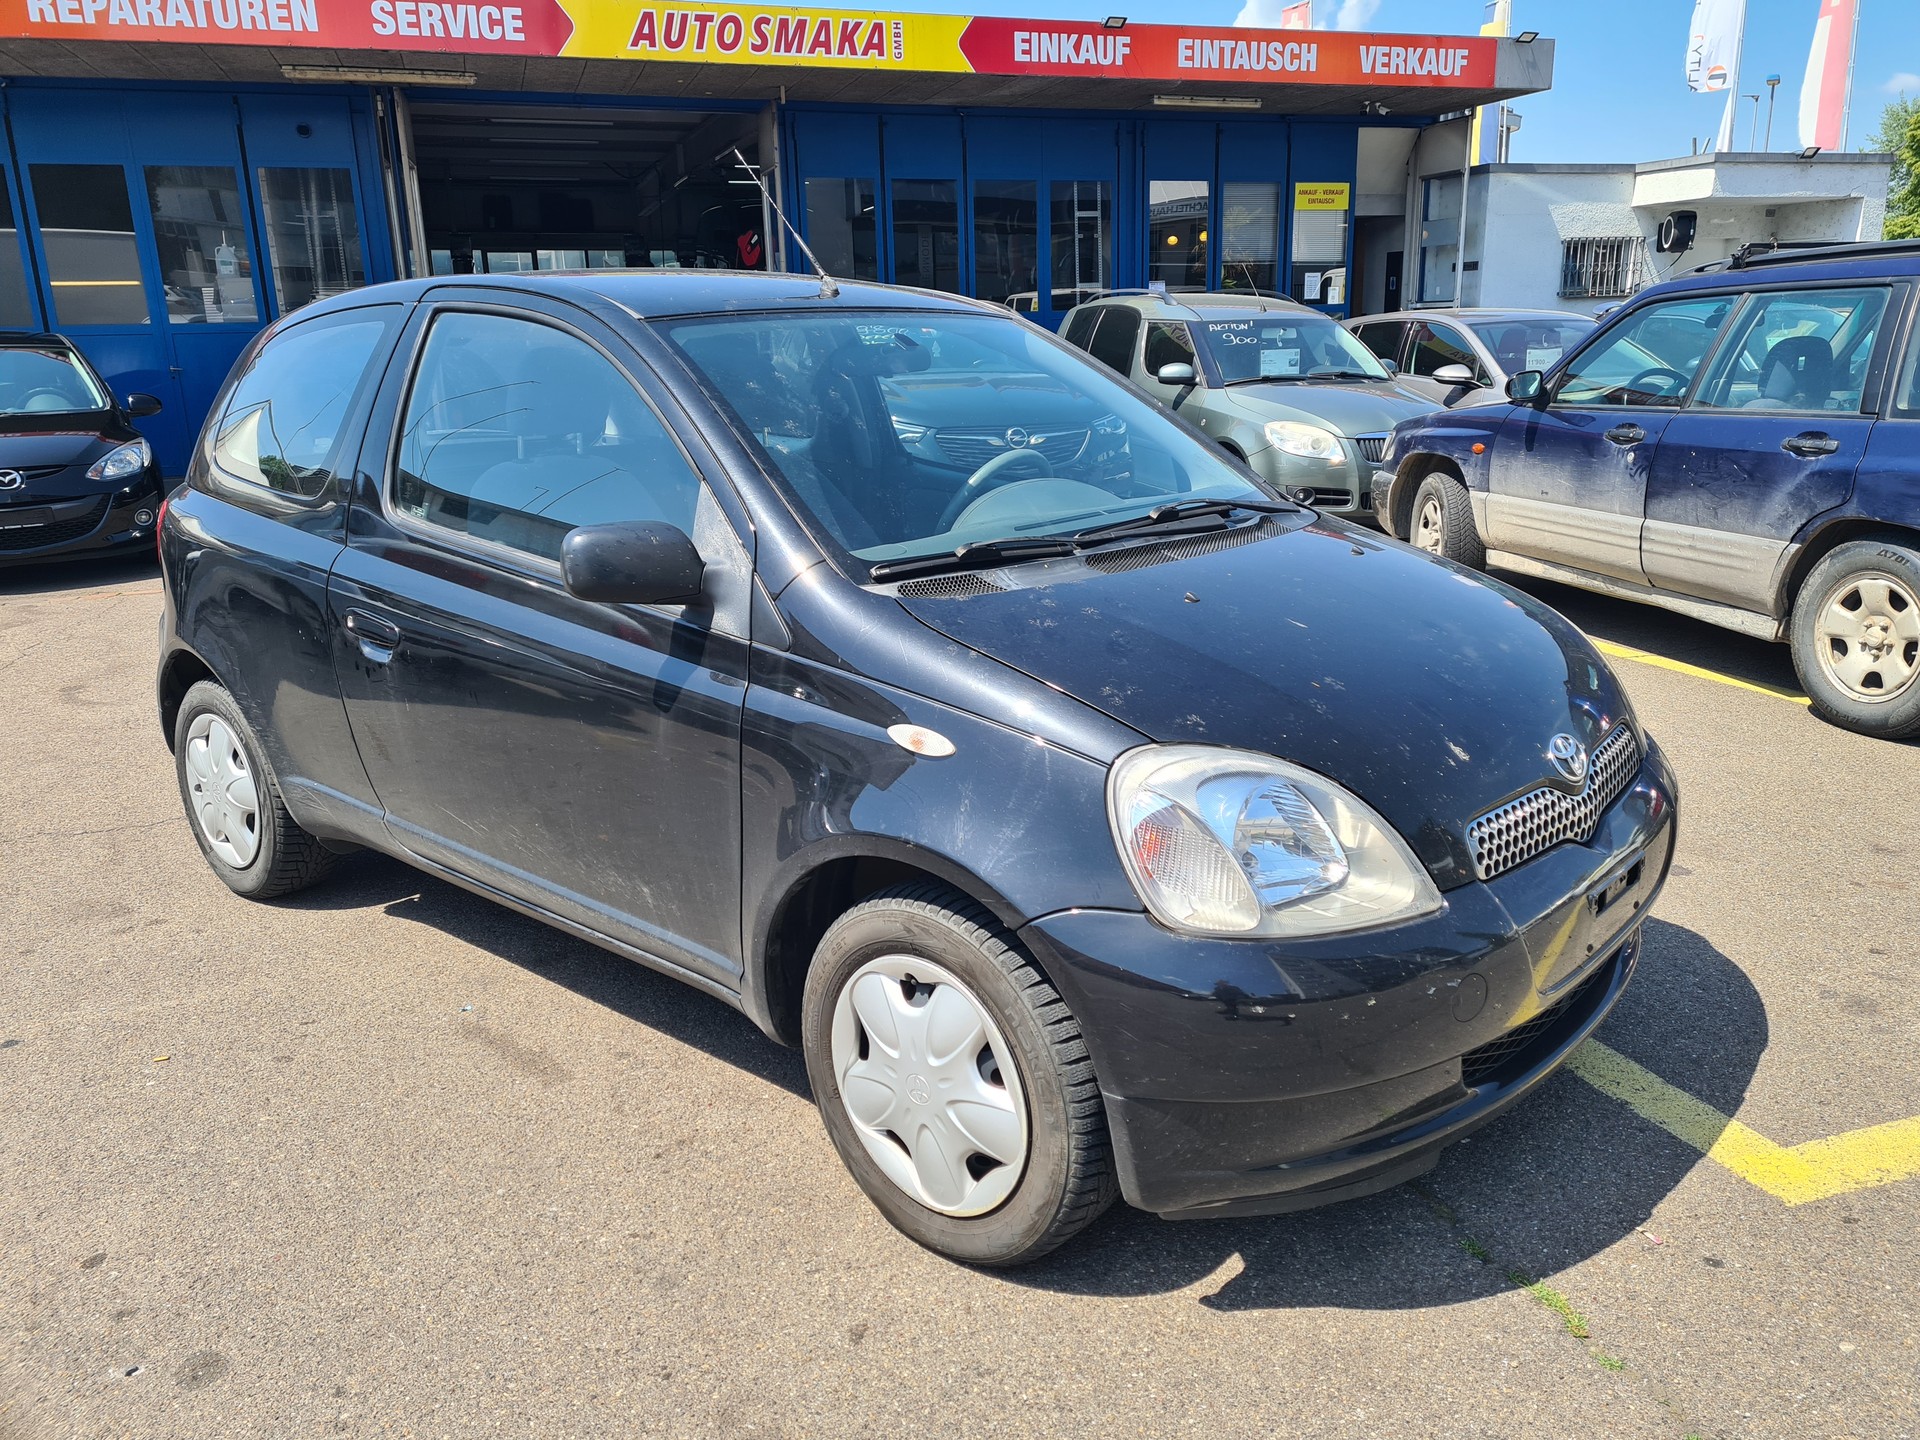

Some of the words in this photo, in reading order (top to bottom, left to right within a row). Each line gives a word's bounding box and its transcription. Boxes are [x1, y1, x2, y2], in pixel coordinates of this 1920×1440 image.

[27, 0, 319, 33] REPARATUREN
[370, 0, 526, 42] SERVICE
[627, 8, 745, 54] AUTO
[748, 14, 888, 60] SMAKA
[892, 20, 904, 61] GMBH
[1013, 31, 1131, 66] EINKAUF
[1177, 38, 1318, 72] EINTAUSCH
[1359, 45, 1469, 77] VERKAUF
[1298, 188, 1318, 197] ANKAUF
[1322, 188, 1345, 197] VERKAUF
[1307, 197, 1335, 205] EINTAUSCH
